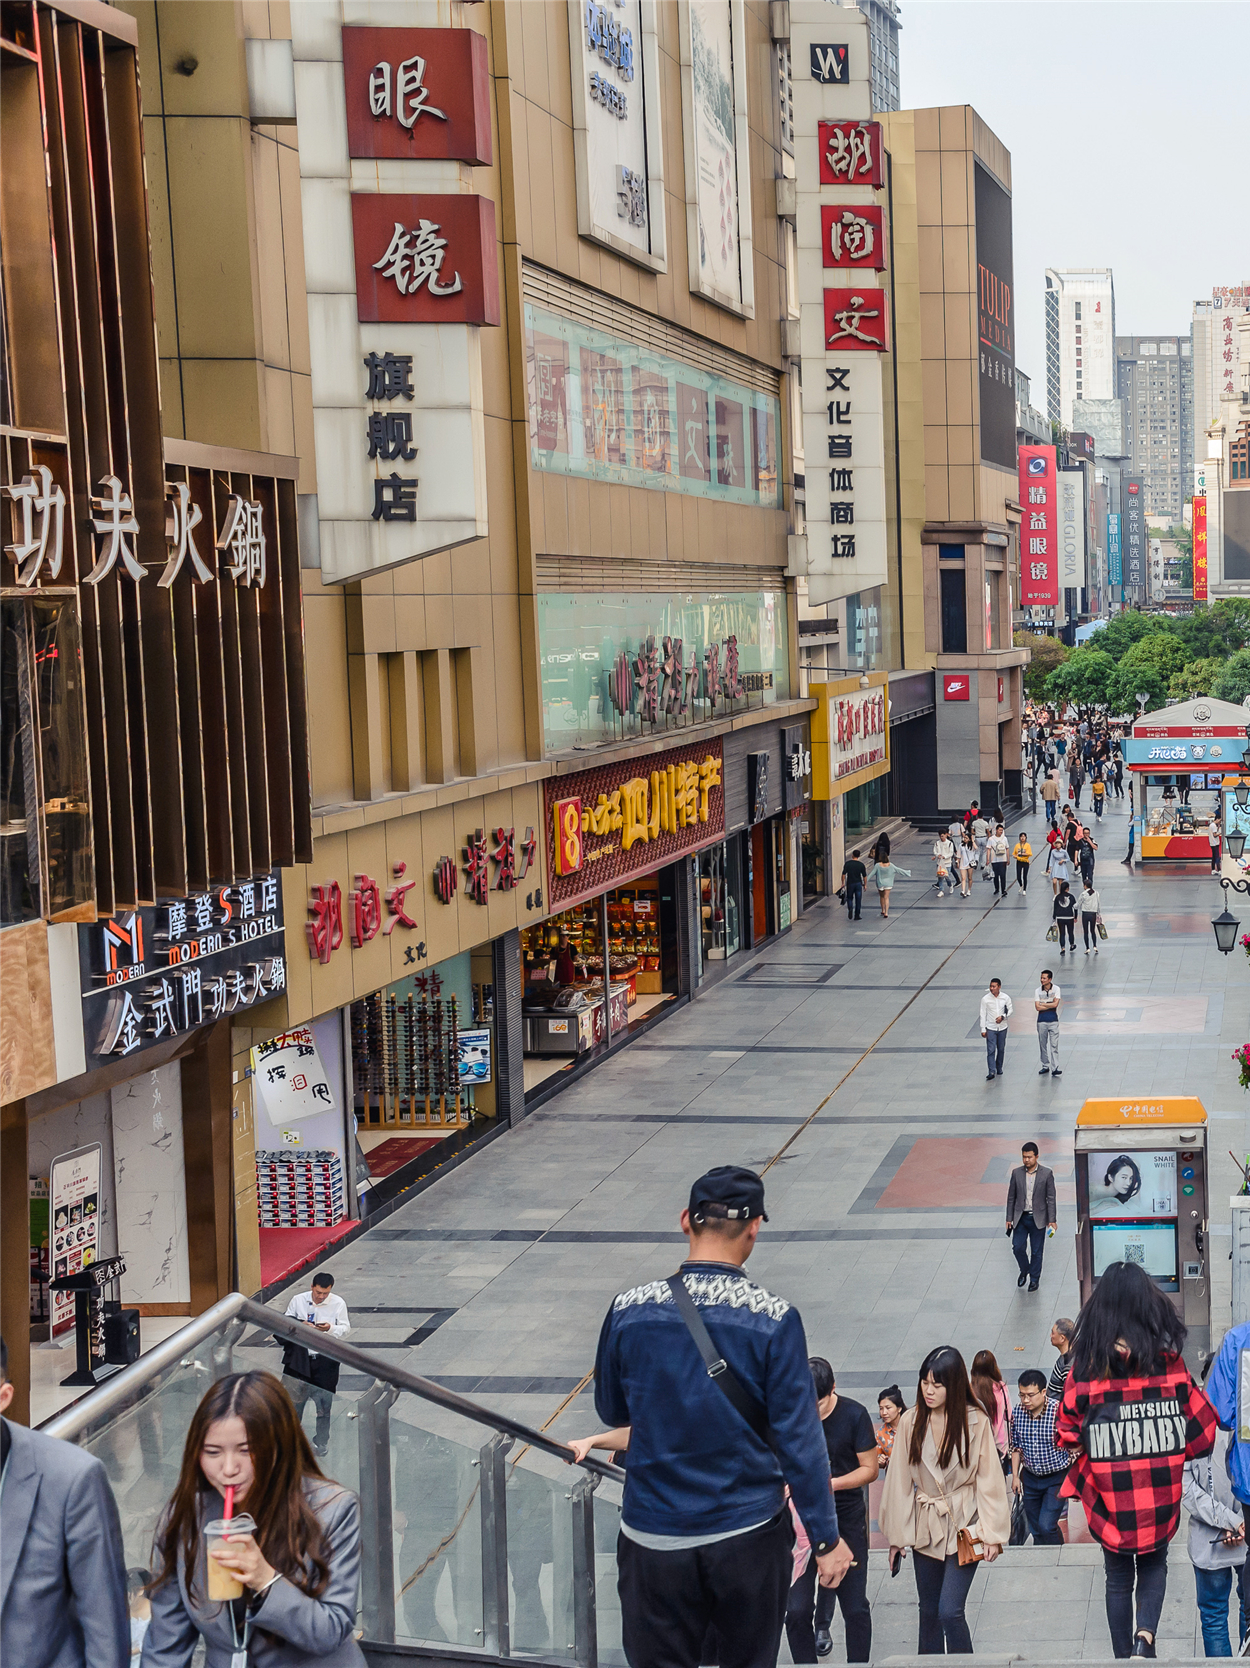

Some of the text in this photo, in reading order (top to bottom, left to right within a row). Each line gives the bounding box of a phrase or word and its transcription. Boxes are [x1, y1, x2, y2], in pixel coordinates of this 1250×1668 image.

[978, 262, 1011, 327] TULIP
[980, 314, 1011, 351] MEDIA
[363, 351, 419, 522] 旗舰店
[825, 366, 856, 559] 文化音体商场
[0, 464, 268, 589] 功夫火鍋
[1028, 485, 1048, 581] 精益眼镜
[1063, 523, 1077, 577] GLORIA
[167, 876, 278, 942] 摩登S酒店
[240, 914, 279, 941] HOTEL
[99, 956, 286, 1056] 金武門 功夫火鍋
[413, 969, 445, 999] 精
[1133, 1104, 1164, 1115] 中国电信
[1153, 1155, 1175, 1163] SNAIL
[1088, 1415, 1187, 1458] MYBABY
